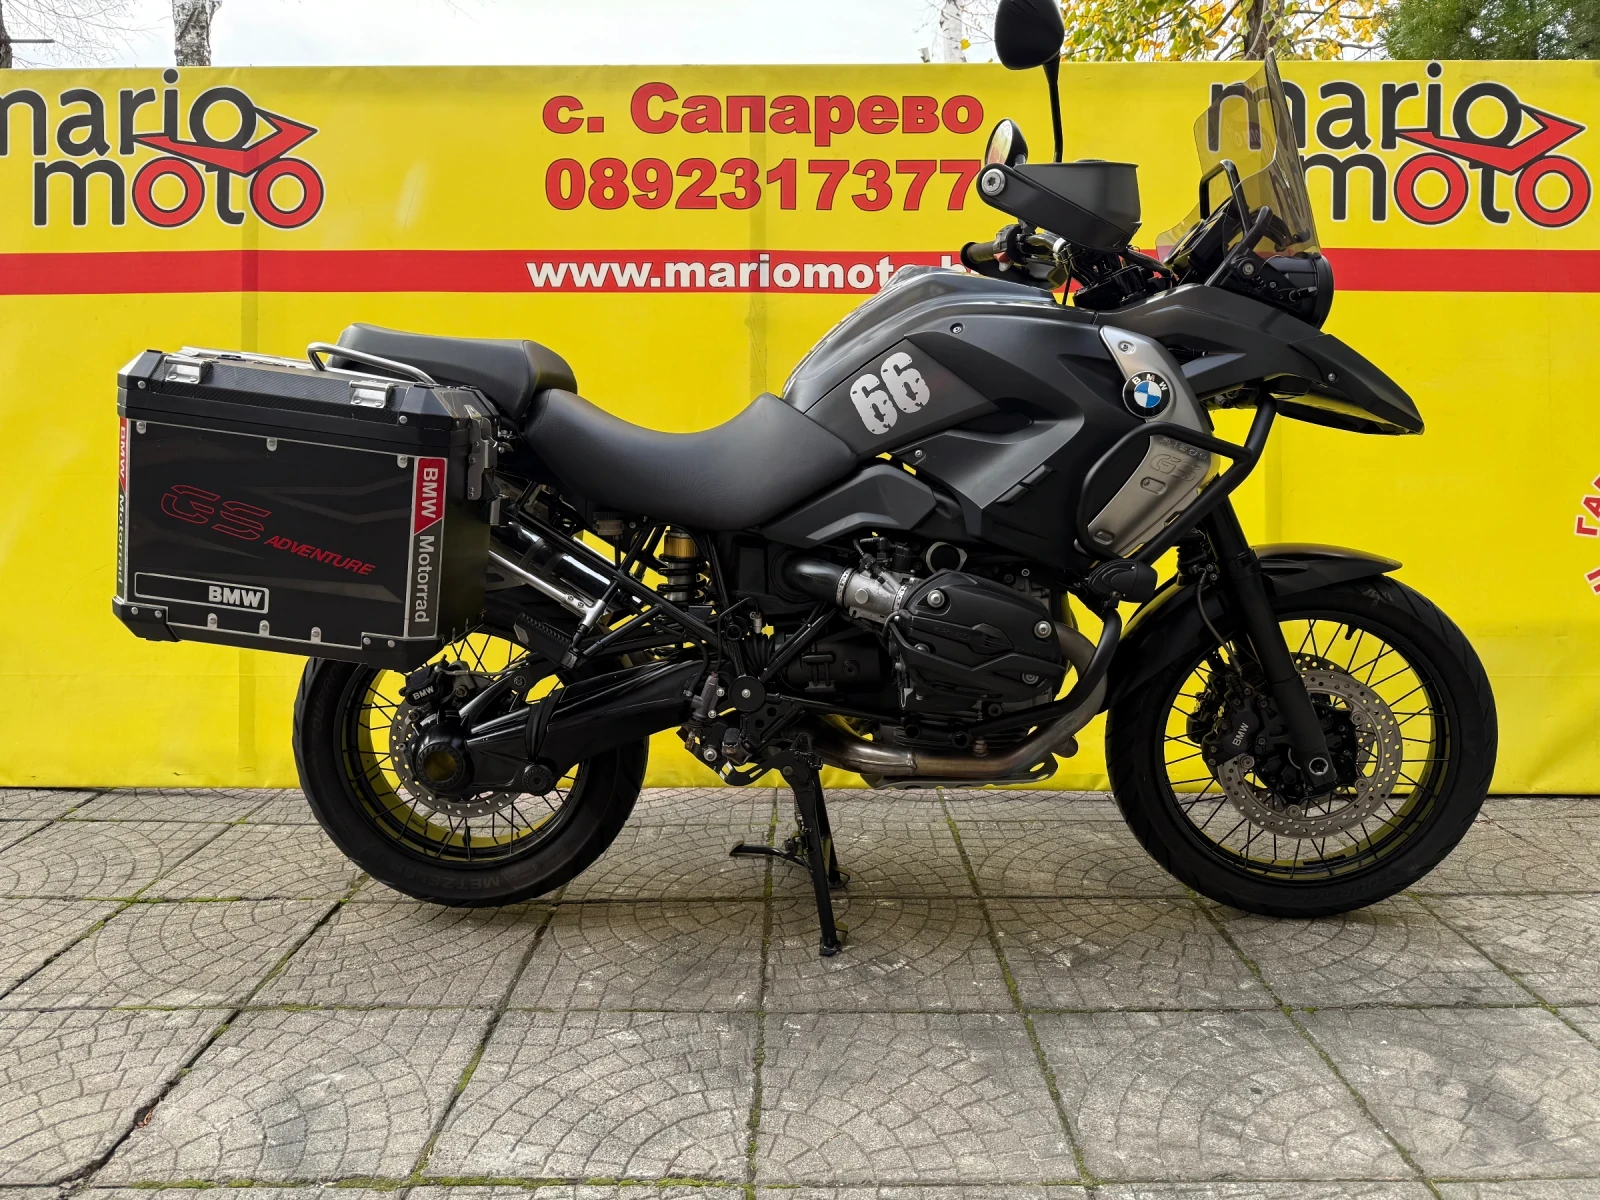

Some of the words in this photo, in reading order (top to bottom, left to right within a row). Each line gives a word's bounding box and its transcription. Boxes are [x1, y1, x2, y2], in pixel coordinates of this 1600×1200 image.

[542, 95, 605, 133] с.
[630, 82, 984, 146] Сапарево
[1207, 61, 1525, 150] mario
[34, 157, 325, 228] moto
[545, 157, 981, 211] 0892317377
[1300, 153, 1591, 228] moto
[526, 254, 980, 289] www.mariomot
[849, 351, 931, 435] 66
[1131, 373, 1168, 392] BMW
[161, 485, 272, 540] GS
[422, 467, 439, 519] BMW
[264, 535, 376, 577] ADVENTURE
[414, 535, 436, 623] Motorrad
[208, 586, 262, 608] BMW
[412, 685, 435, 701] BMW
[1232, 721, 1250, 748] BMW
